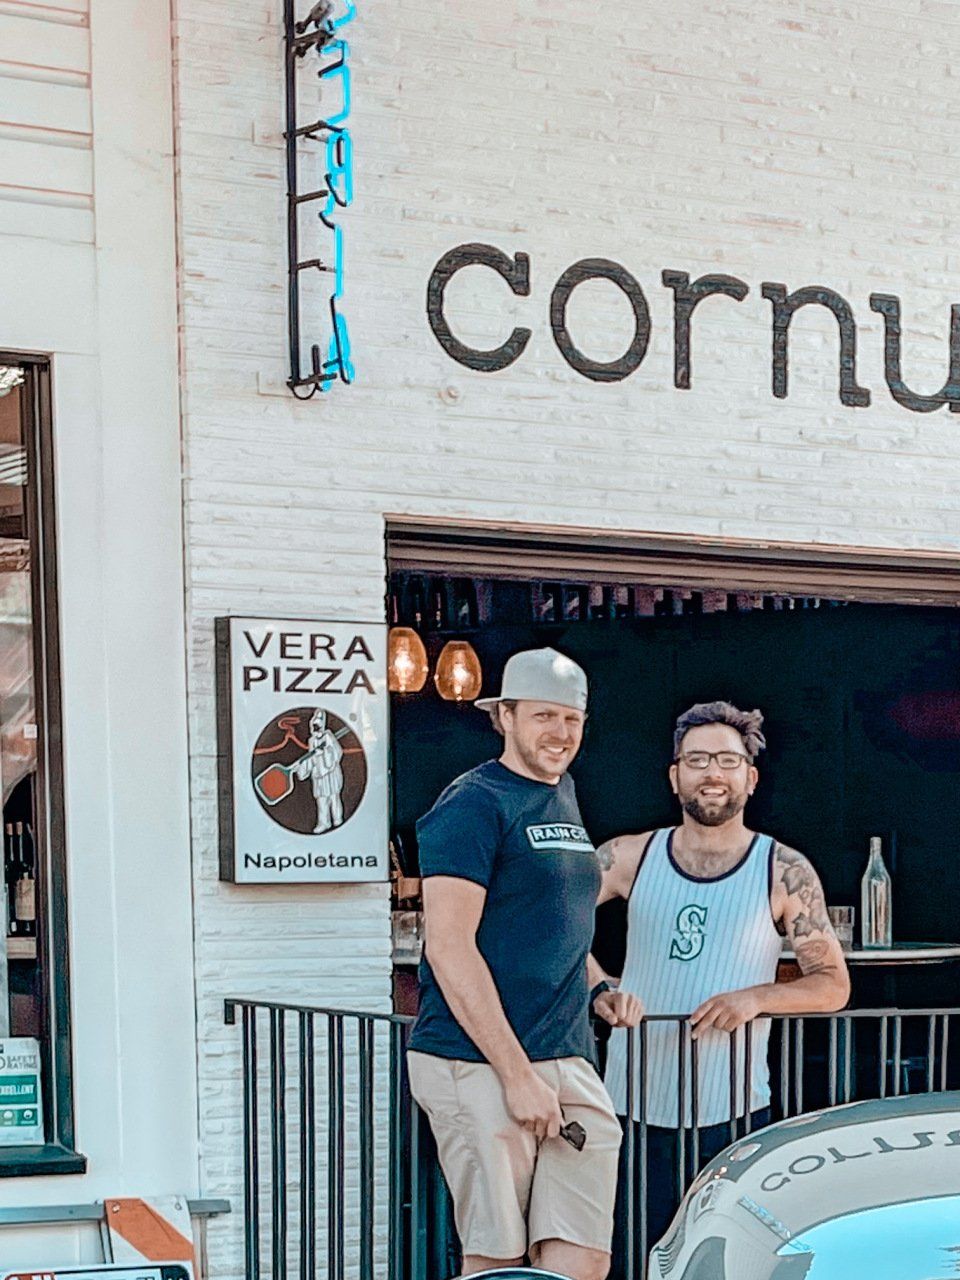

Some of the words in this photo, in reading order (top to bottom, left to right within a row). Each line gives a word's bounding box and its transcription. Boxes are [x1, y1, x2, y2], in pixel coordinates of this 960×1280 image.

[243, 630, 375, 662] VERA
[242, 665, 377, 695] PIZZA
[244, 852, 379, 872] Napoletana
